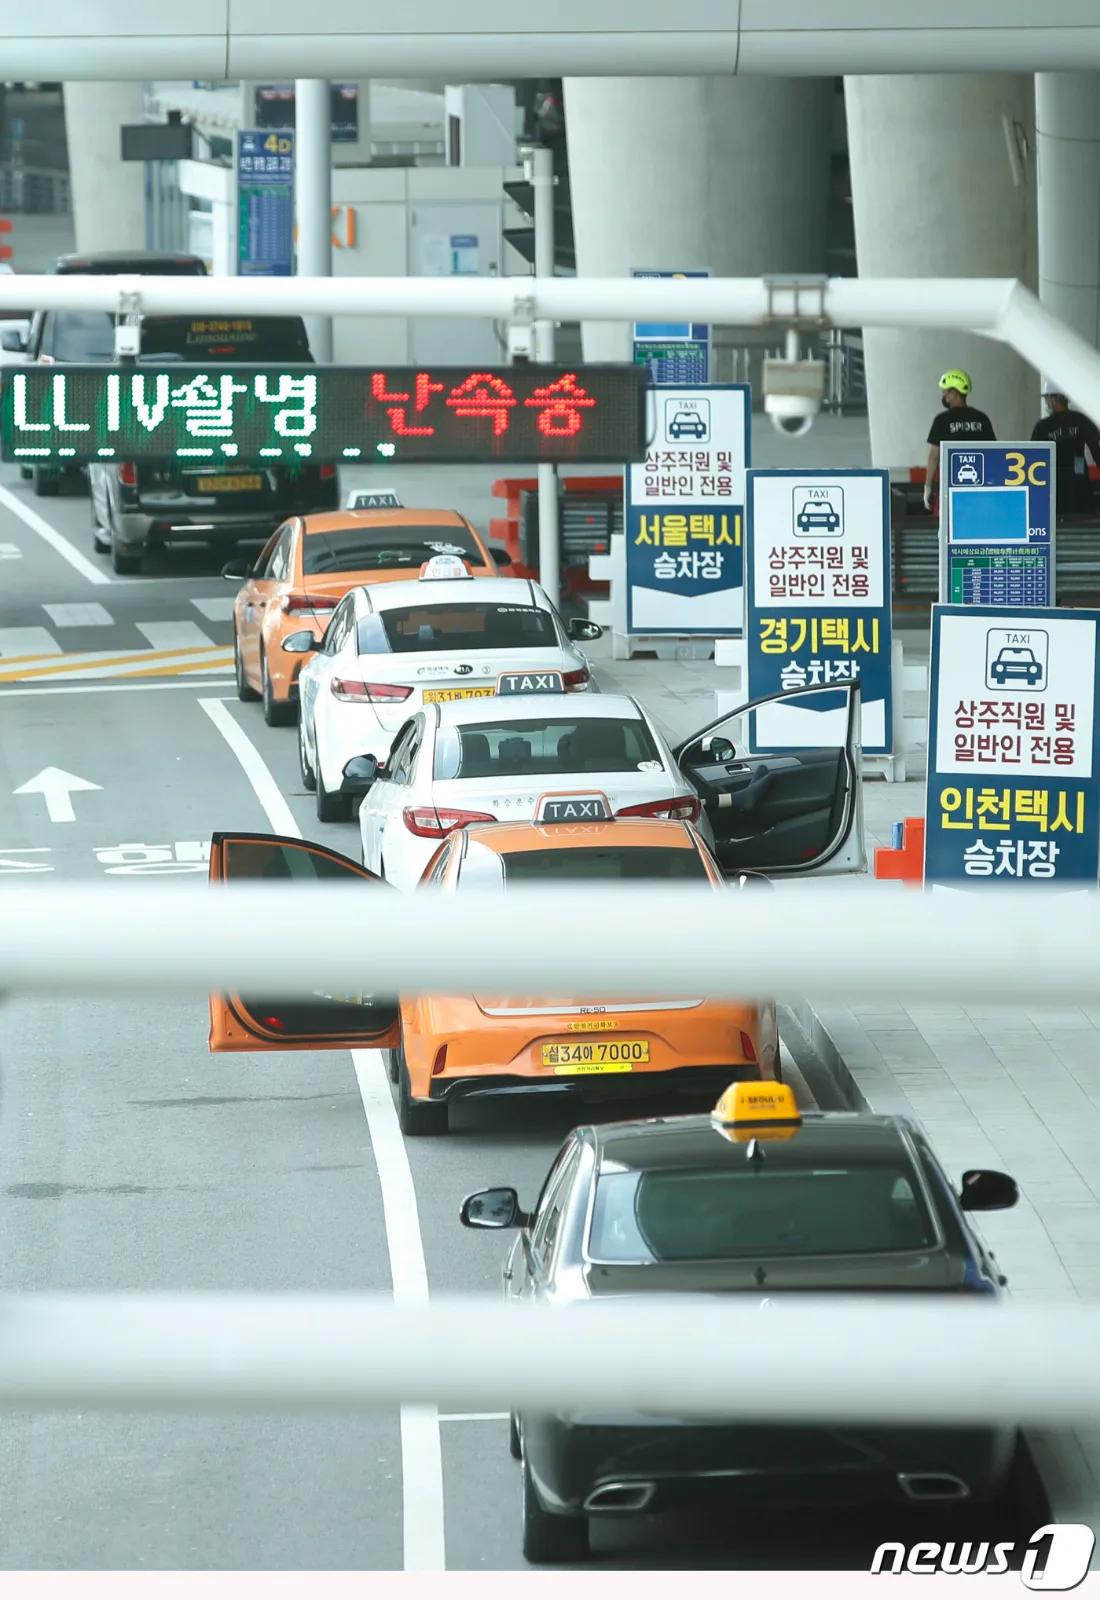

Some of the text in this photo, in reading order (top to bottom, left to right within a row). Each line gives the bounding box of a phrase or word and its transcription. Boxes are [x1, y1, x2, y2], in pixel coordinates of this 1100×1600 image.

[264, 134, 292, 153] 4D
[678, 401, 697, 410] TAXI
[949, 421, 982, 433] SPIDER
[645, 451, 732, 472] 상주직원 및
[959, 455, 976, 463] TAXI
[645, 475, 733, 496] 일반인 전용
[808, 490, 829, 498] TAXI
[359, 497, 393, 506] TAXI
[634, 514, 741, 547] 서울택시
[654, 551, 725, 580] 승차장
[768, 546, 869, 570] 상주직원 및
[769, 574, 869, 598] 일반인 전용
[759, 618, 879, 654] 경기택시
[1005, 633, 1030, 644] TAXI
[507, 675, 554, 690] TAXI
[954, 700, 1076, 732] 상주직원 및
[954, 734, 1075, 766] 일반인 전용
[550, 803, 599, 818] TAXI
[940, 787, 1085, 834] 인천택시
[963, 838, 1060, 878] 승차장
[597, 1043, 643, 1062] 7000
